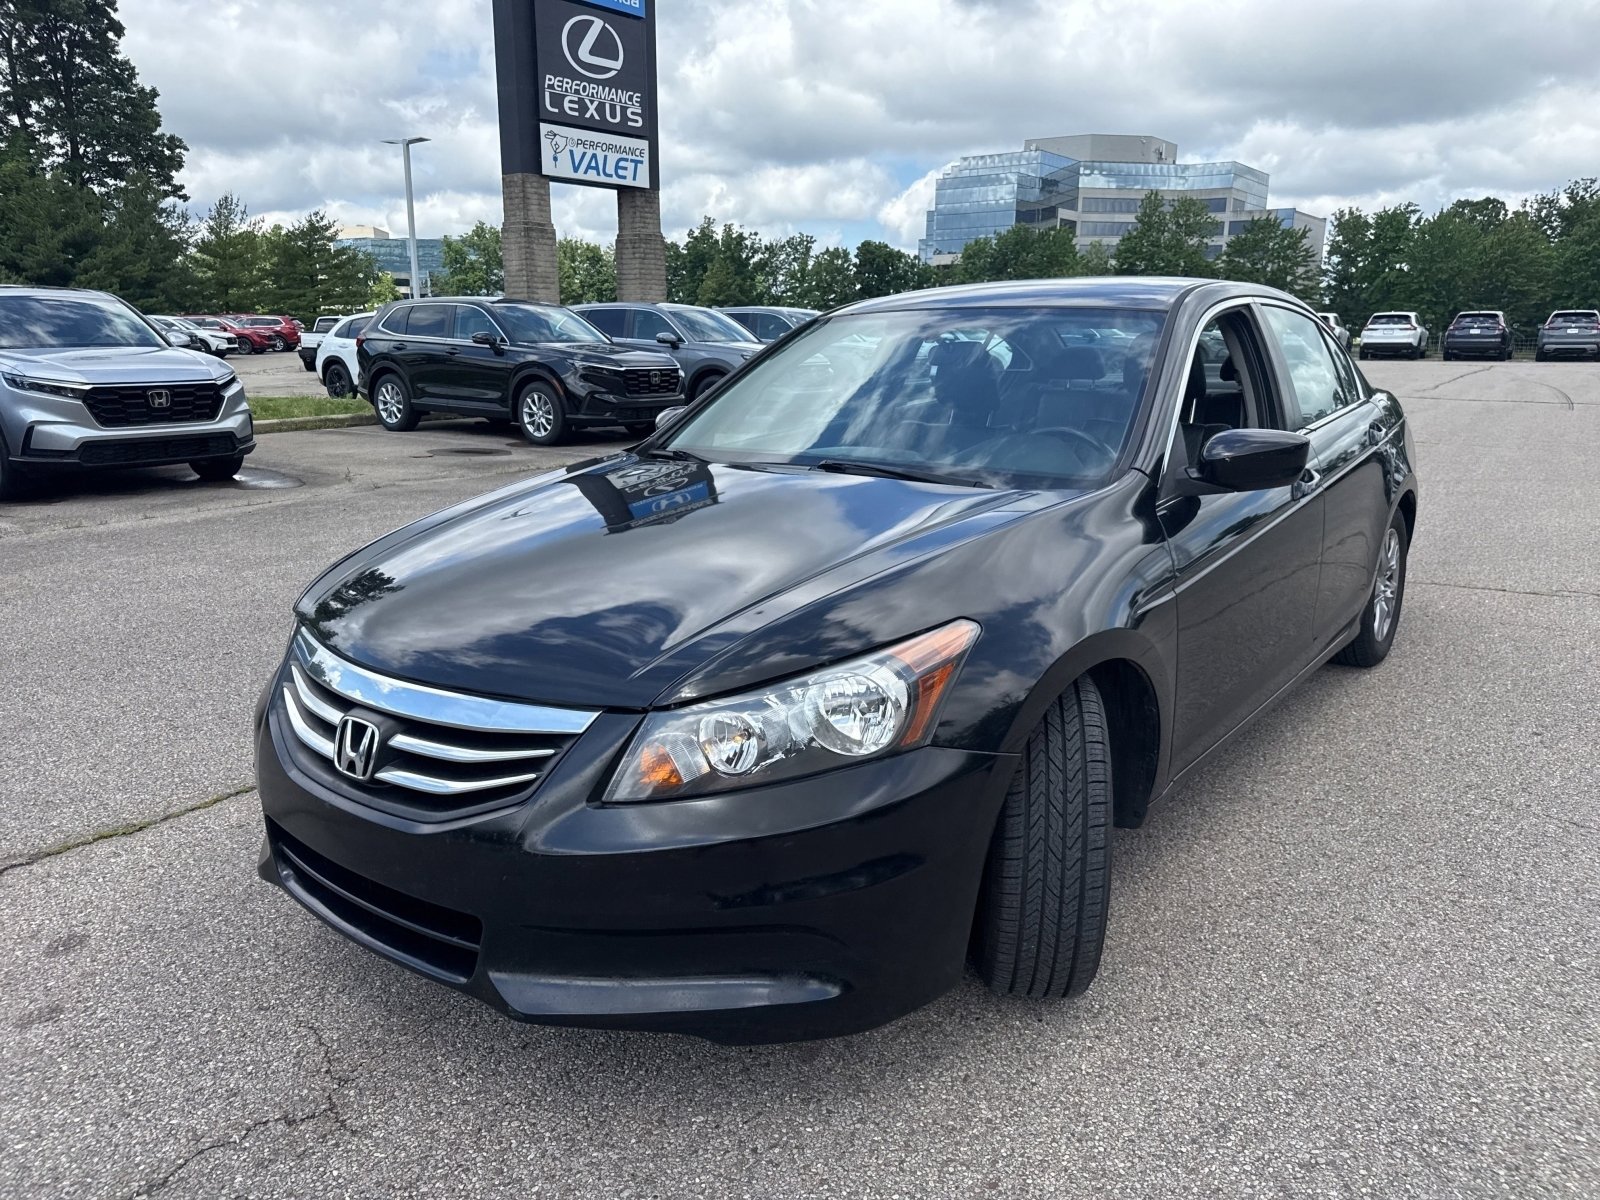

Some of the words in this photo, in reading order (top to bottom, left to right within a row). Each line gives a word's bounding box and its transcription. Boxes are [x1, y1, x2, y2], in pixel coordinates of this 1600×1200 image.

[544, 74, 642, 107] PERFORMANCE
[544, 91, 643, 127] LEXUS
[575, 138, 646, 159] PERFORMANCE
[569, 149, 644, 182] VALET
